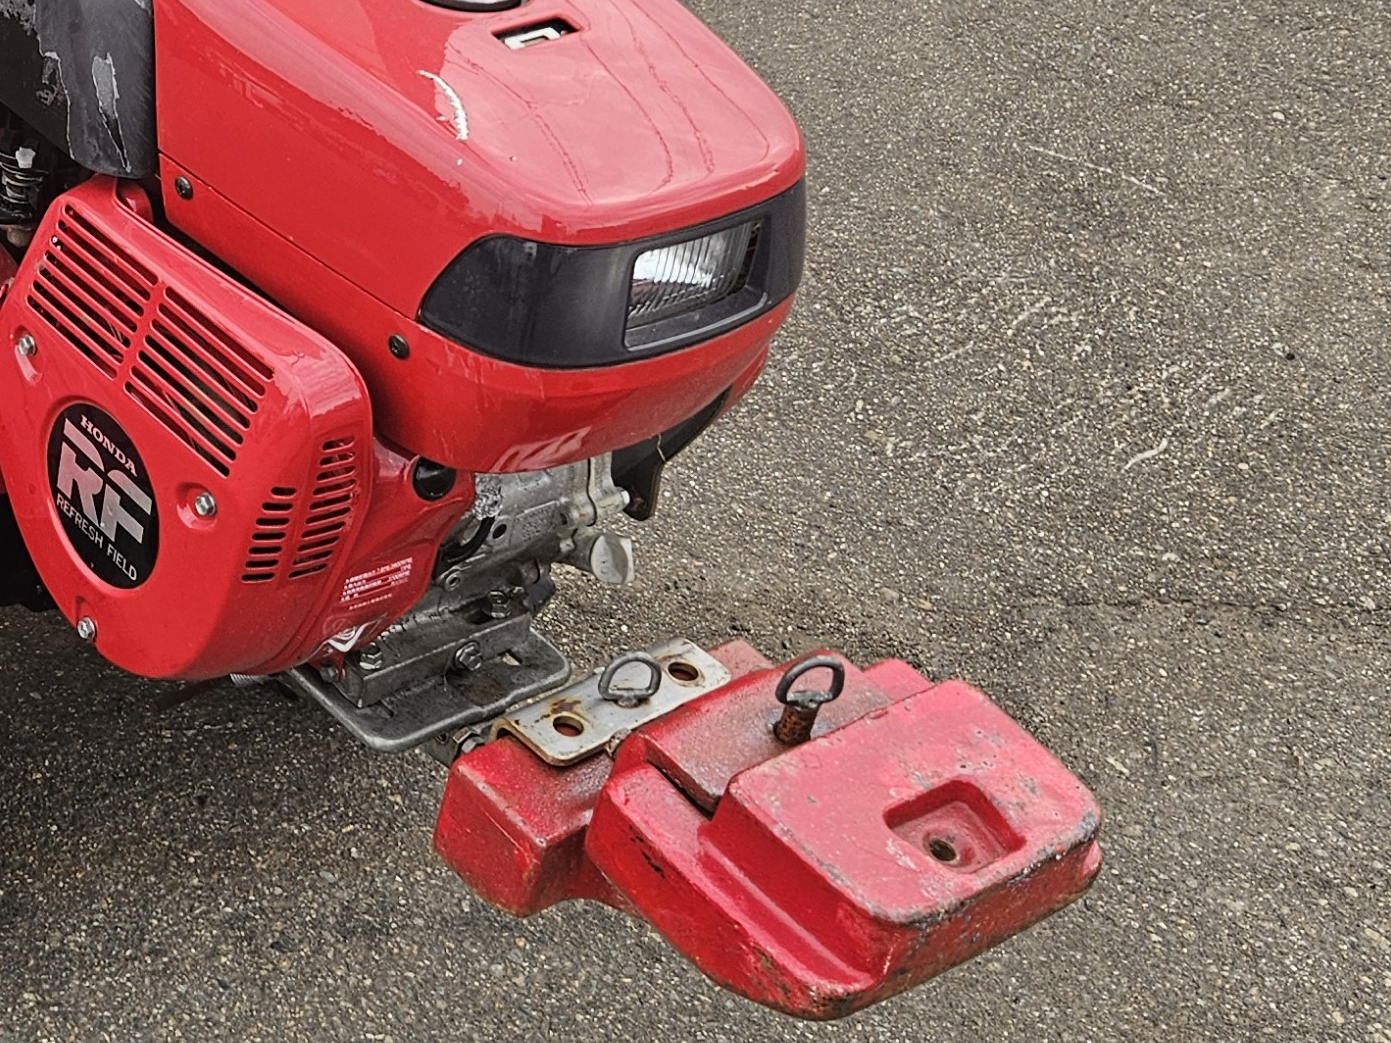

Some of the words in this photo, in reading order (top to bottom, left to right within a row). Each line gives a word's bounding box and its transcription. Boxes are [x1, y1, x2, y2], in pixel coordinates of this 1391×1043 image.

[56, 417, 153, 544] RF
[80, 414, 137, 477] HONDA
[56, 493, 104, 549] REFRESH
[106, 546, 137, 581] FIELD
